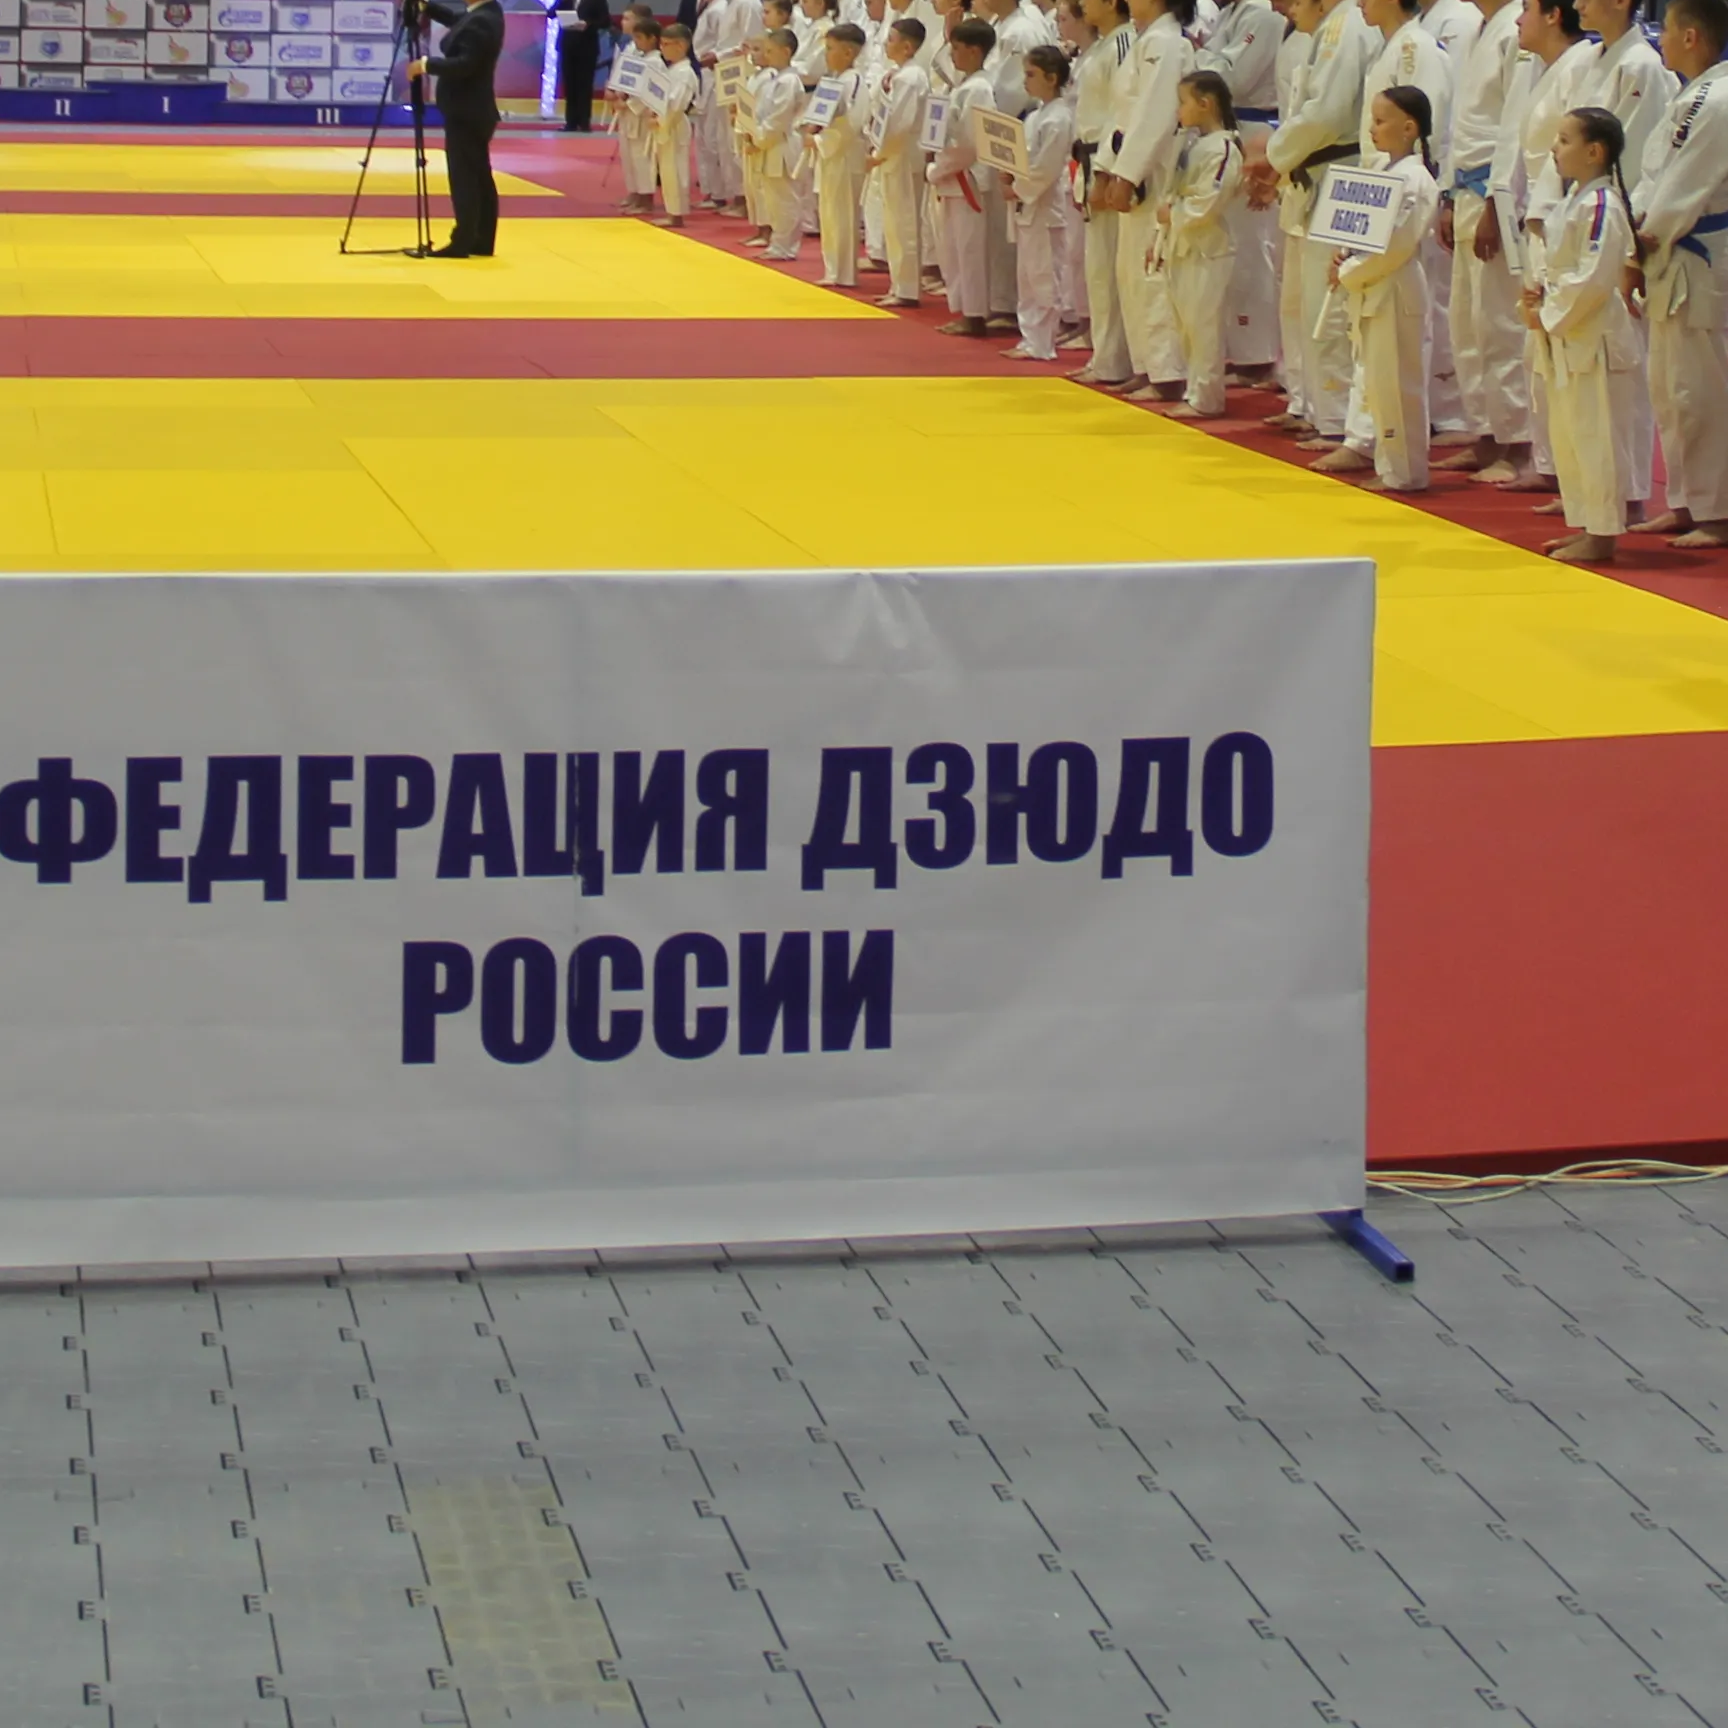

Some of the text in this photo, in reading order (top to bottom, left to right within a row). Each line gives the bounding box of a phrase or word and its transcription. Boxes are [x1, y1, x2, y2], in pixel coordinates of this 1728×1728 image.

[1330, 208, 1369, 235] ОБЛАСТЬ
[802, 730, 1275, 891] ДЗЮДО
[401, 928, 896, 1064] РОССИИ
